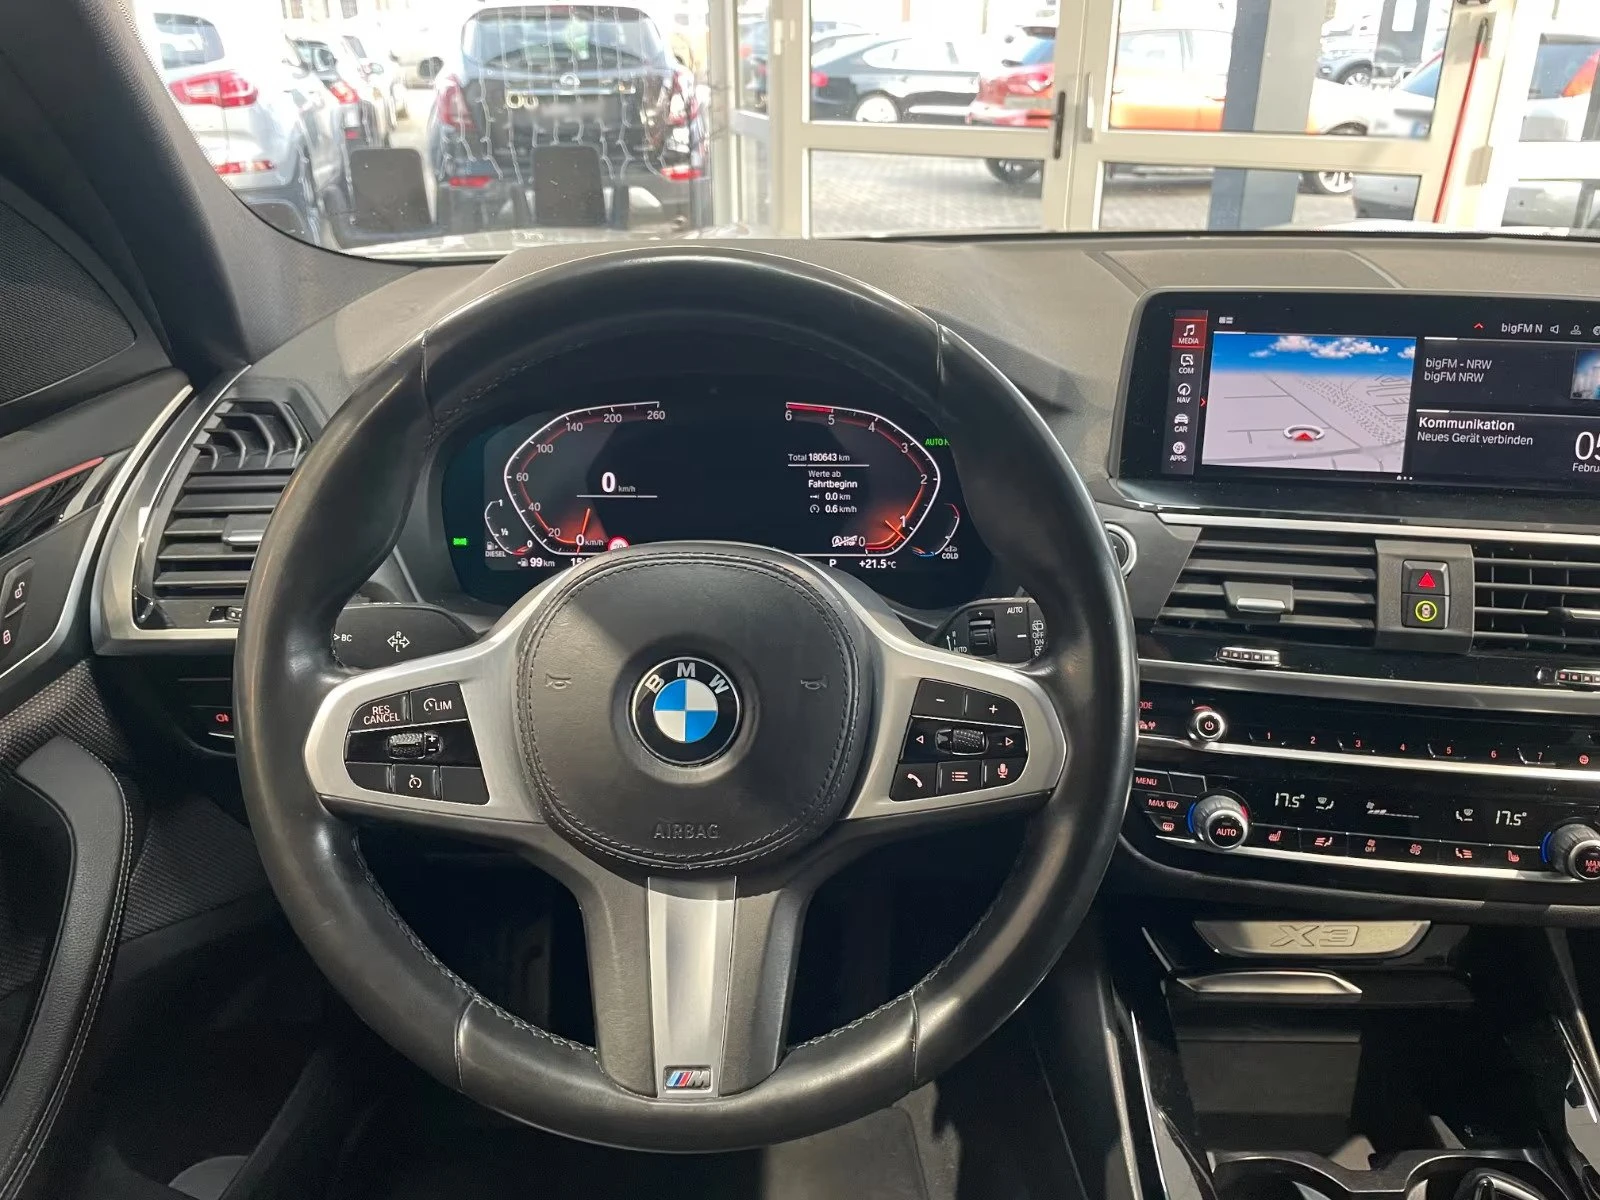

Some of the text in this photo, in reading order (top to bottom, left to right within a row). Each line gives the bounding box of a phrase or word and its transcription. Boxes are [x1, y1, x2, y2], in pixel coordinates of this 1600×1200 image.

[1502, 323, 1543, 334] bigFM N
[1178, 337, 1199, 345] MEDIA
[1425, 358, 1457, 370] bigFM
[1467, 360, 1492, 369] NRW
[1424, 372, 1484, 383] bigFM NRW
[604, 414, 622, 423] 200
[646, 410, 666, 420] 260
[785, 411, 792, 420] 6
[828, 415, 835, 425] 5
[566, 423, 583, 432] 140
[868, 422, 875, 432] 4
[1419, 417, 1515, 431] Kommunikation
[1417, 432, 1533, 445] Neues Gerät verbinden
[536, 444, 553, 453] 100
[902, 443, 908, 453] 3
[808, 453, 837, 462] 180643
[1170, 454, 1187, 462] APPS
[1572, 462, 1600, 472] Febru
[516, 473, 529, 482] 60
[808, 470, 841, 478] Werte ab
[601, 472, 636, 493] 0 km/h
[920, 475, 928, 484] 2
[808, 480, 857, 490] Fahrtbeginn
[825, 493, 838, 501] 0.0
[528, 503, 540, 512] 40
[825, 505, 857, 513] 0.6 km/h
[900, 516, 906, 527] 1
[548, 528, 560, 537] 20
[527, 540, 533, 548] 0
[576, 535, 584, 546] 0
[858, 536, 865, 547] 0
[530, 558, 555, 568] 99 km
[829, 559, 837, 568] P
[341, 634, 352, 642] BC
[644, 662, 729, 694] BMW
[372, 704, 390, 715] RES
[435, 700, 452, 711] LIM
[1140, 701, 1153, 709] ODE
[363, 712, 400, 725] CANCEL
[1136, 776, 1157, 786] MENU
[1148, 799, 1164, 808] MAX
[653, 823, 720, 839] AIRBAG
[1216, 828, 1237, 837] AUTO
[1270, 924, 1359, 948] X3
